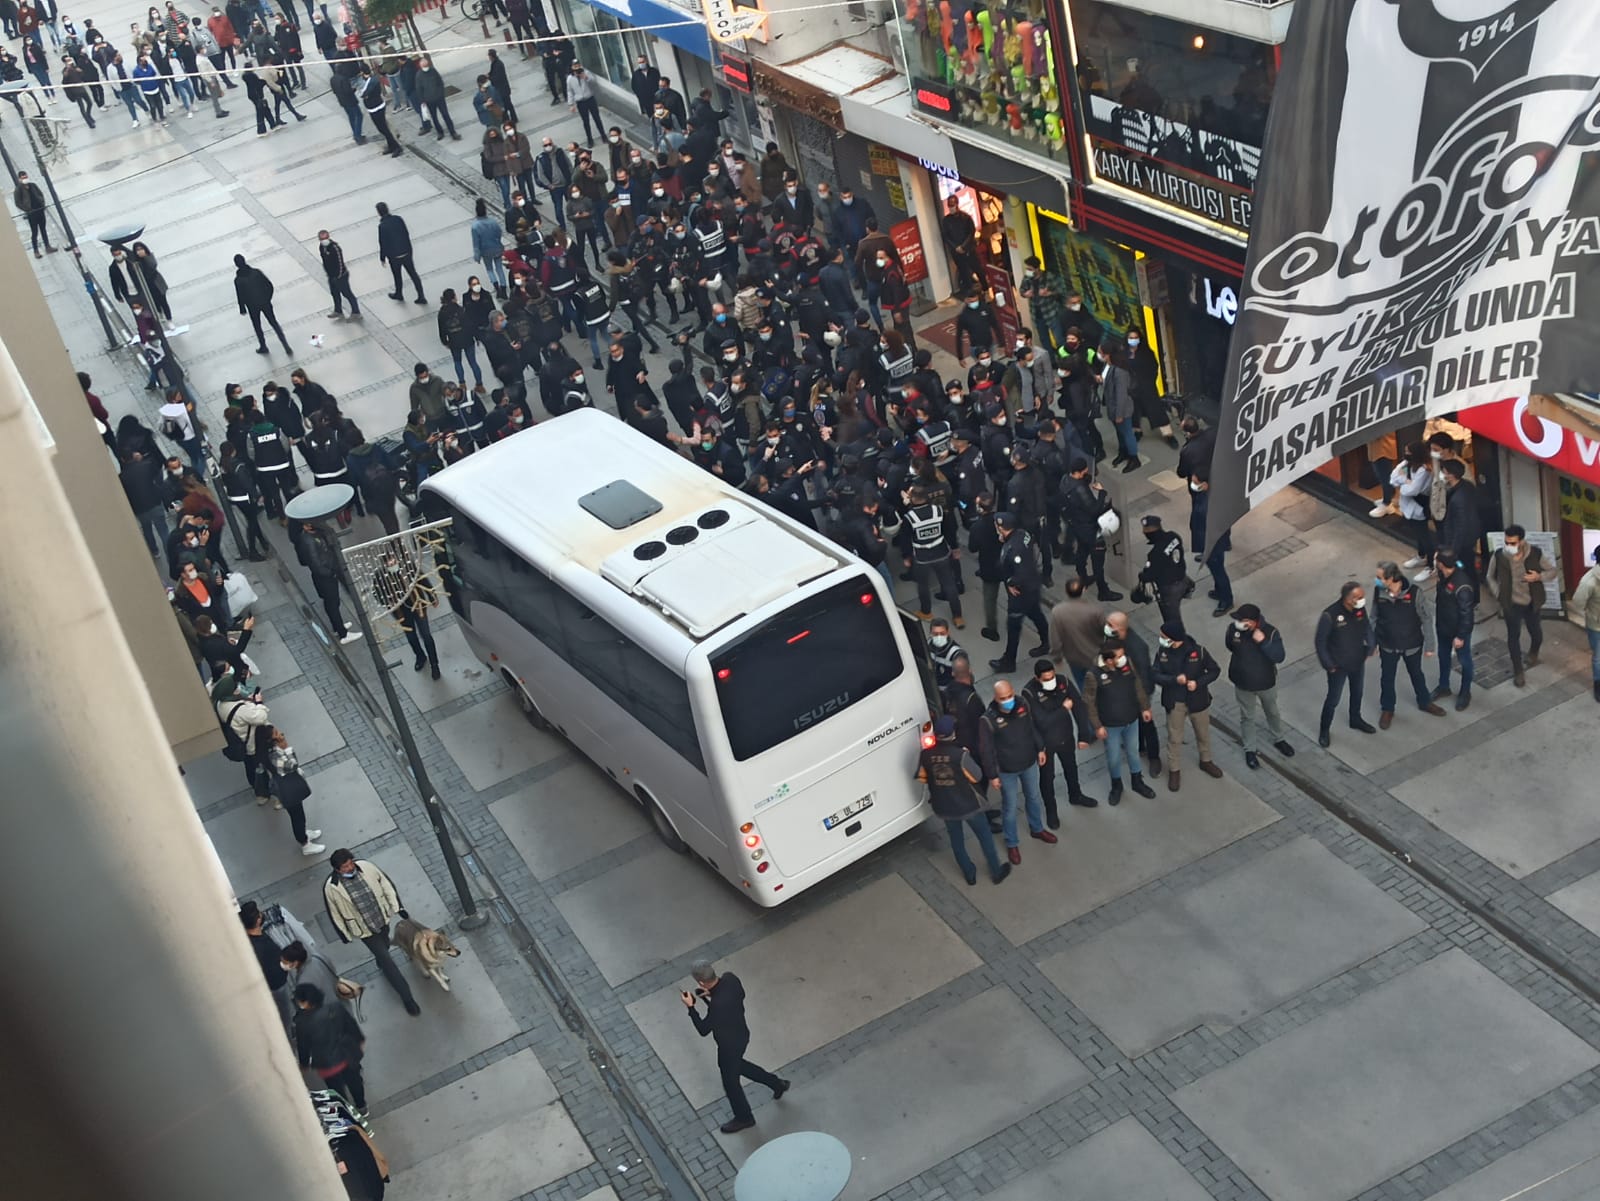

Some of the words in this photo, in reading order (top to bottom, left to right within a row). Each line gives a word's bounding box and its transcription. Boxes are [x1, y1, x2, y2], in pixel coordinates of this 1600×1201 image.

[1457, 12, 1516, 52] 1914
[1094, 149, 1143, 188] KARYA
[1145, 166, 1225, 219] YURTDIŞI
[1233, 291, 1424, 402] BÜYÜK
[1235, 366, 1340, 450] SÜPER
[1246, 366, 1428, 498] BAŞARILAR
[1433, 340, 1542, 399] DİLER
[793, 691, 850, 730] ISUZU
